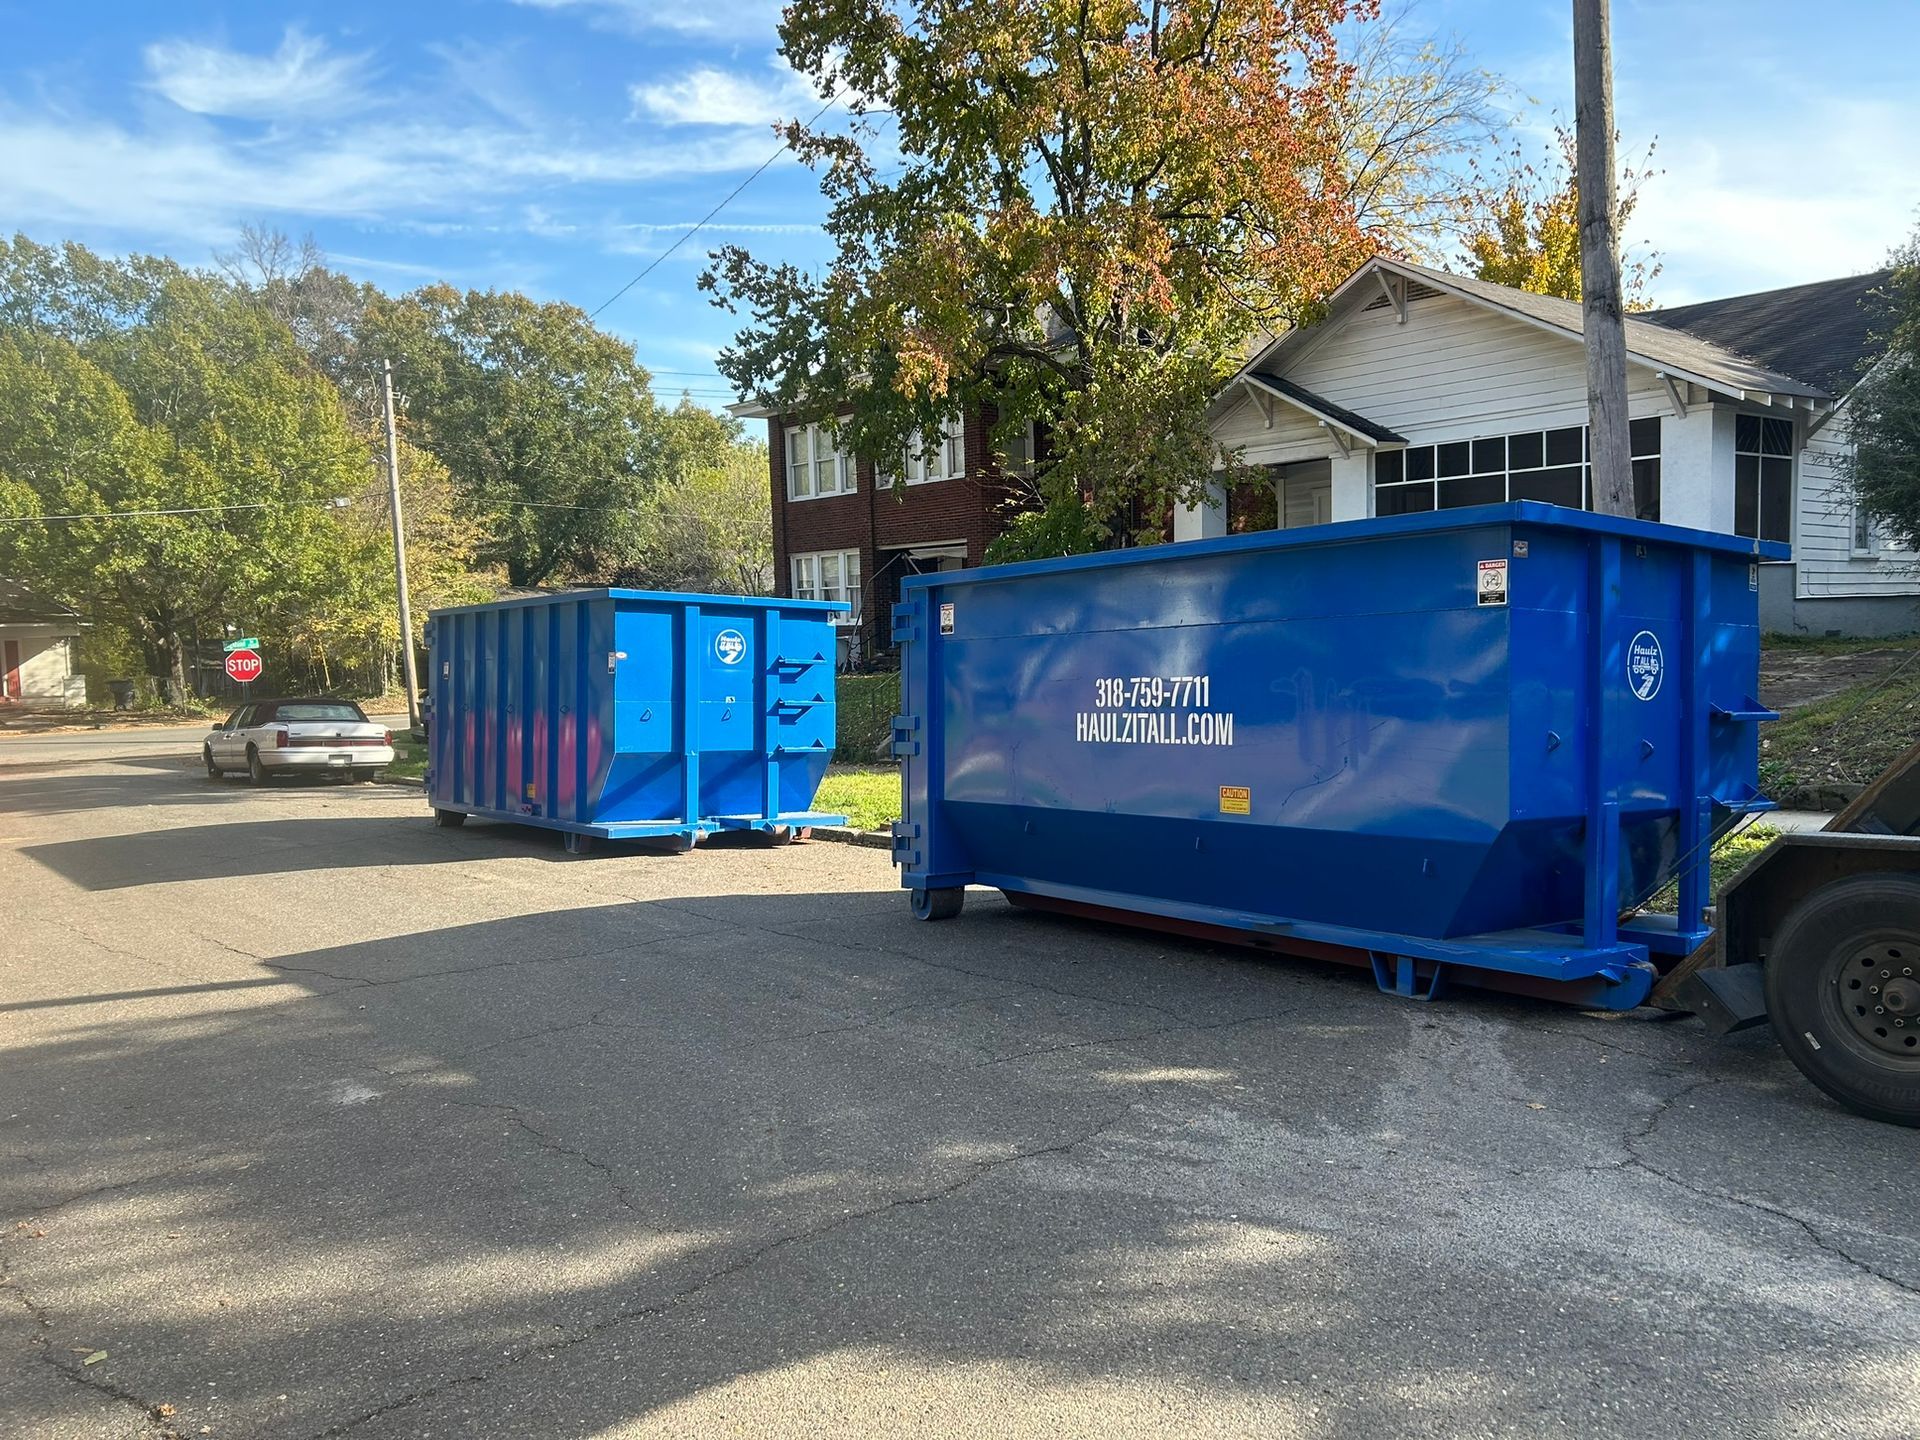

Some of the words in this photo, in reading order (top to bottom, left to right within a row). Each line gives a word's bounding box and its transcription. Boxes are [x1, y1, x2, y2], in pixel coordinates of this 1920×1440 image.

[1634, 645, 1657, 655] Haulz
[228, 659, 259, 672] STOP
[1095, 675, 1209, 708] 318-759-7711
[1076, 712, 1233, 746] HAULZITALL.COM
[1222, 788, 1248, 799] CAUTION
